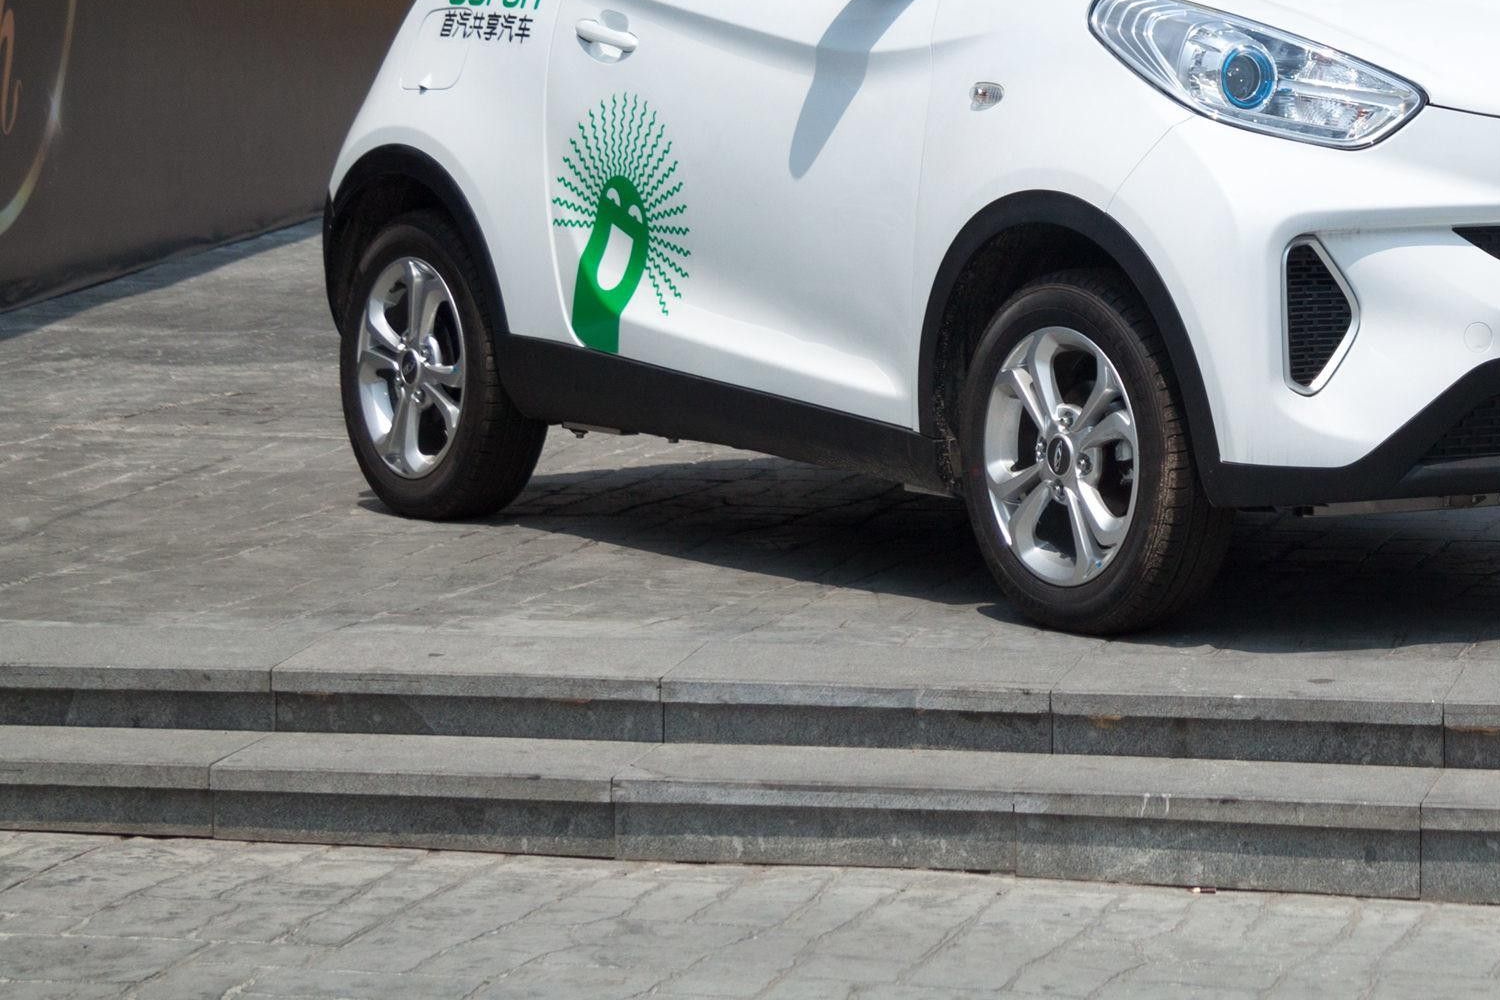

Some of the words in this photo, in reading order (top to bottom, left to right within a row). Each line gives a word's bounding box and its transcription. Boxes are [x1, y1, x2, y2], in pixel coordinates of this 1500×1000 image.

[440, 10, 534, 43] 首汽共享汽车
